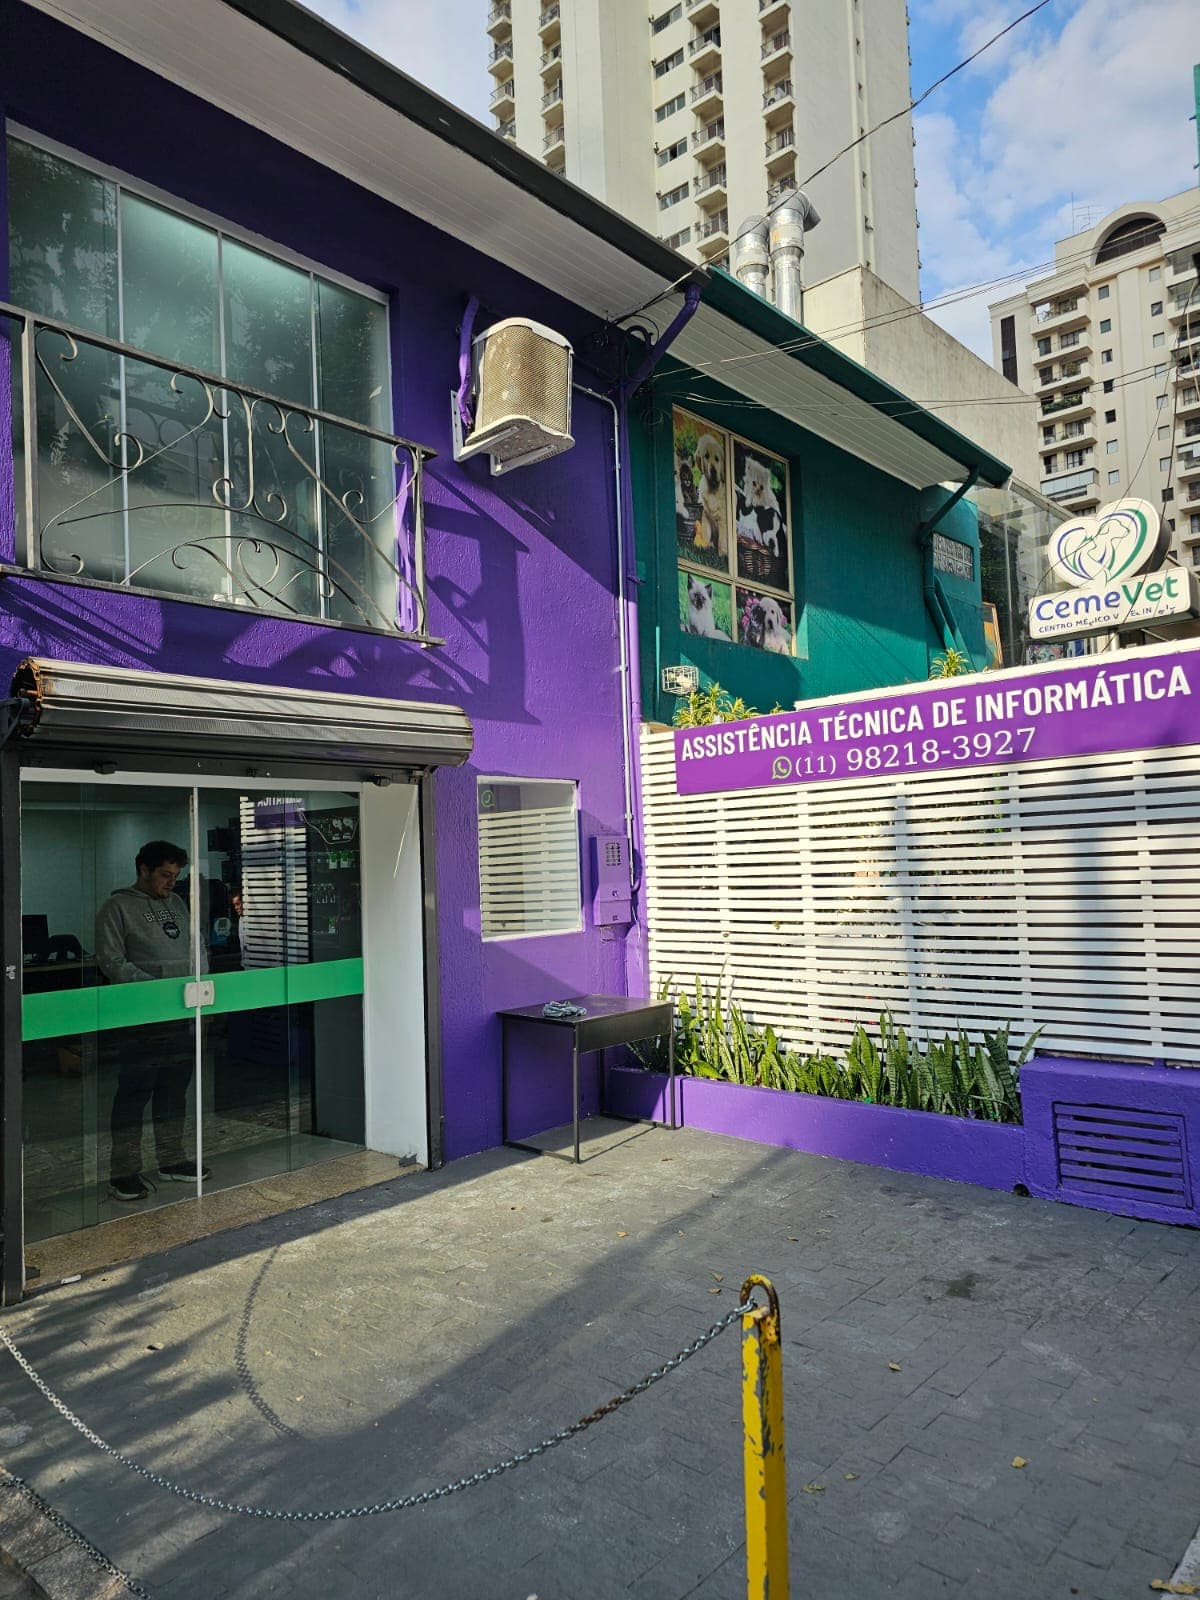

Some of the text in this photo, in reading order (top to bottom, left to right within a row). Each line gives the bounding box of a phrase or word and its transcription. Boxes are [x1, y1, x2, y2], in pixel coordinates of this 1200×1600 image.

[681, 665, 1192, 761] ASSISTÊNCIA TÉCNICA DE INFORMÁTICA
[795, 727, 1037, 777] (11) 98218-3927
